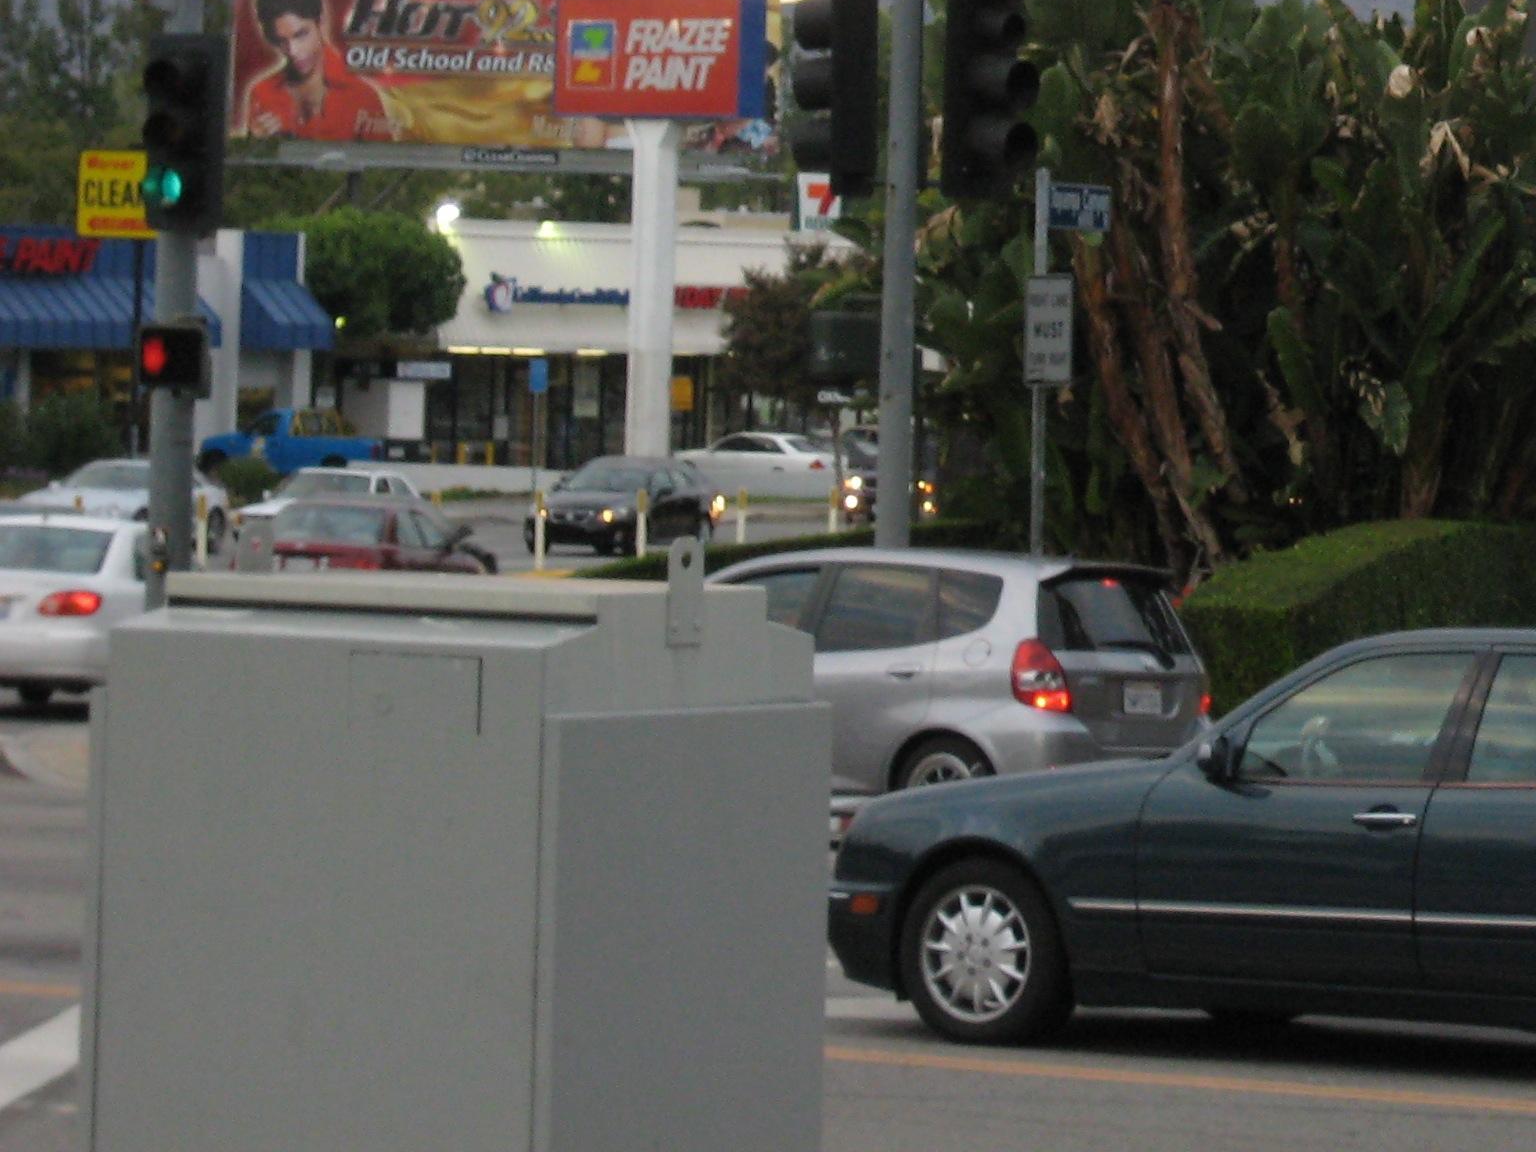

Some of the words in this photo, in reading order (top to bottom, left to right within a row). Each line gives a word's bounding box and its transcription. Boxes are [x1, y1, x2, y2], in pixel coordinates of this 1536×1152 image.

[624, 18, 733, 54] FRAZEE
[347, 47, 389, 67] Old
[393, 48, 475, 70] School
[476, 50, 525, 71] and
[623, 55, 716, 91] PAINT
[85, 179, 142, 205] CLEA
